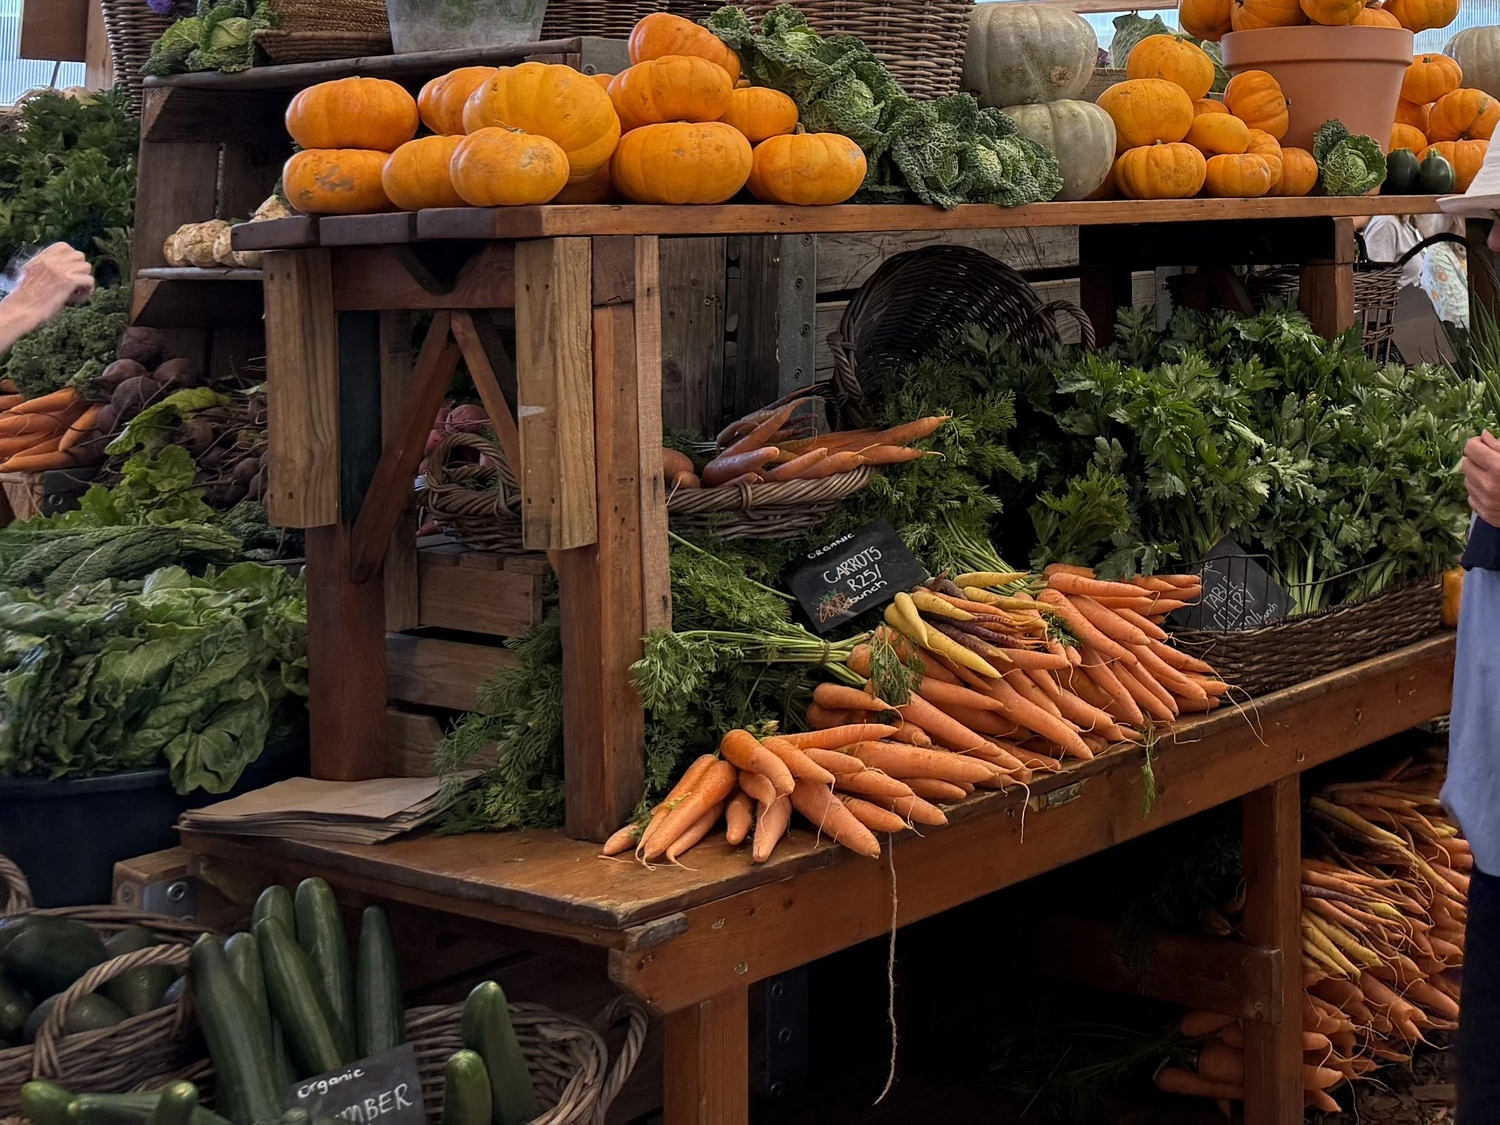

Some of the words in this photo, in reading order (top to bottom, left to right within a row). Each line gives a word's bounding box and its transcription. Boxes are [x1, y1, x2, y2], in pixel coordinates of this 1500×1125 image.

[807, 533, 855, 559] ORGANIC
[823, 545, 882, 584] CARROTS
[846, 563, 882, 592] R25/
[848, 580, 888, 604] bunch
[1213, 582, 1255, 630] CELERY
[335, 1083, 413, 1123] MBER
